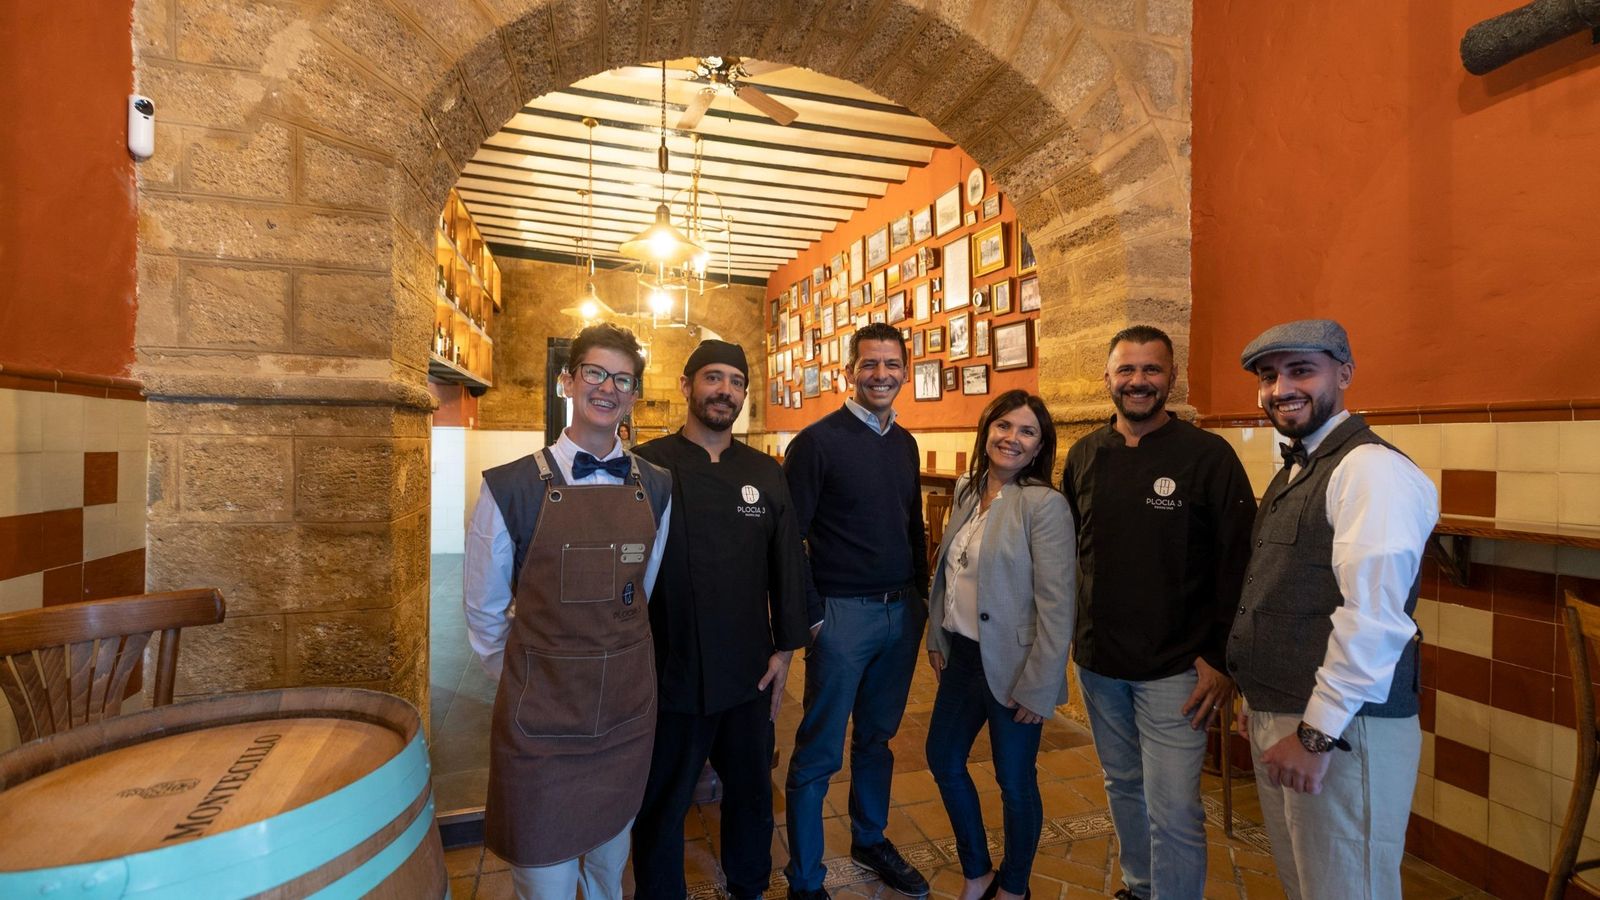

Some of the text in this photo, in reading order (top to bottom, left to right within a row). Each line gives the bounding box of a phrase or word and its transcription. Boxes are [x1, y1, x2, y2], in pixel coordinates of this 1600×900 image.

[1146, 498, 1175, 506] PLOCIA
[737, 506, 761, 514] PLOCIA
[161, 734, 282, 842] MONTECILLO
